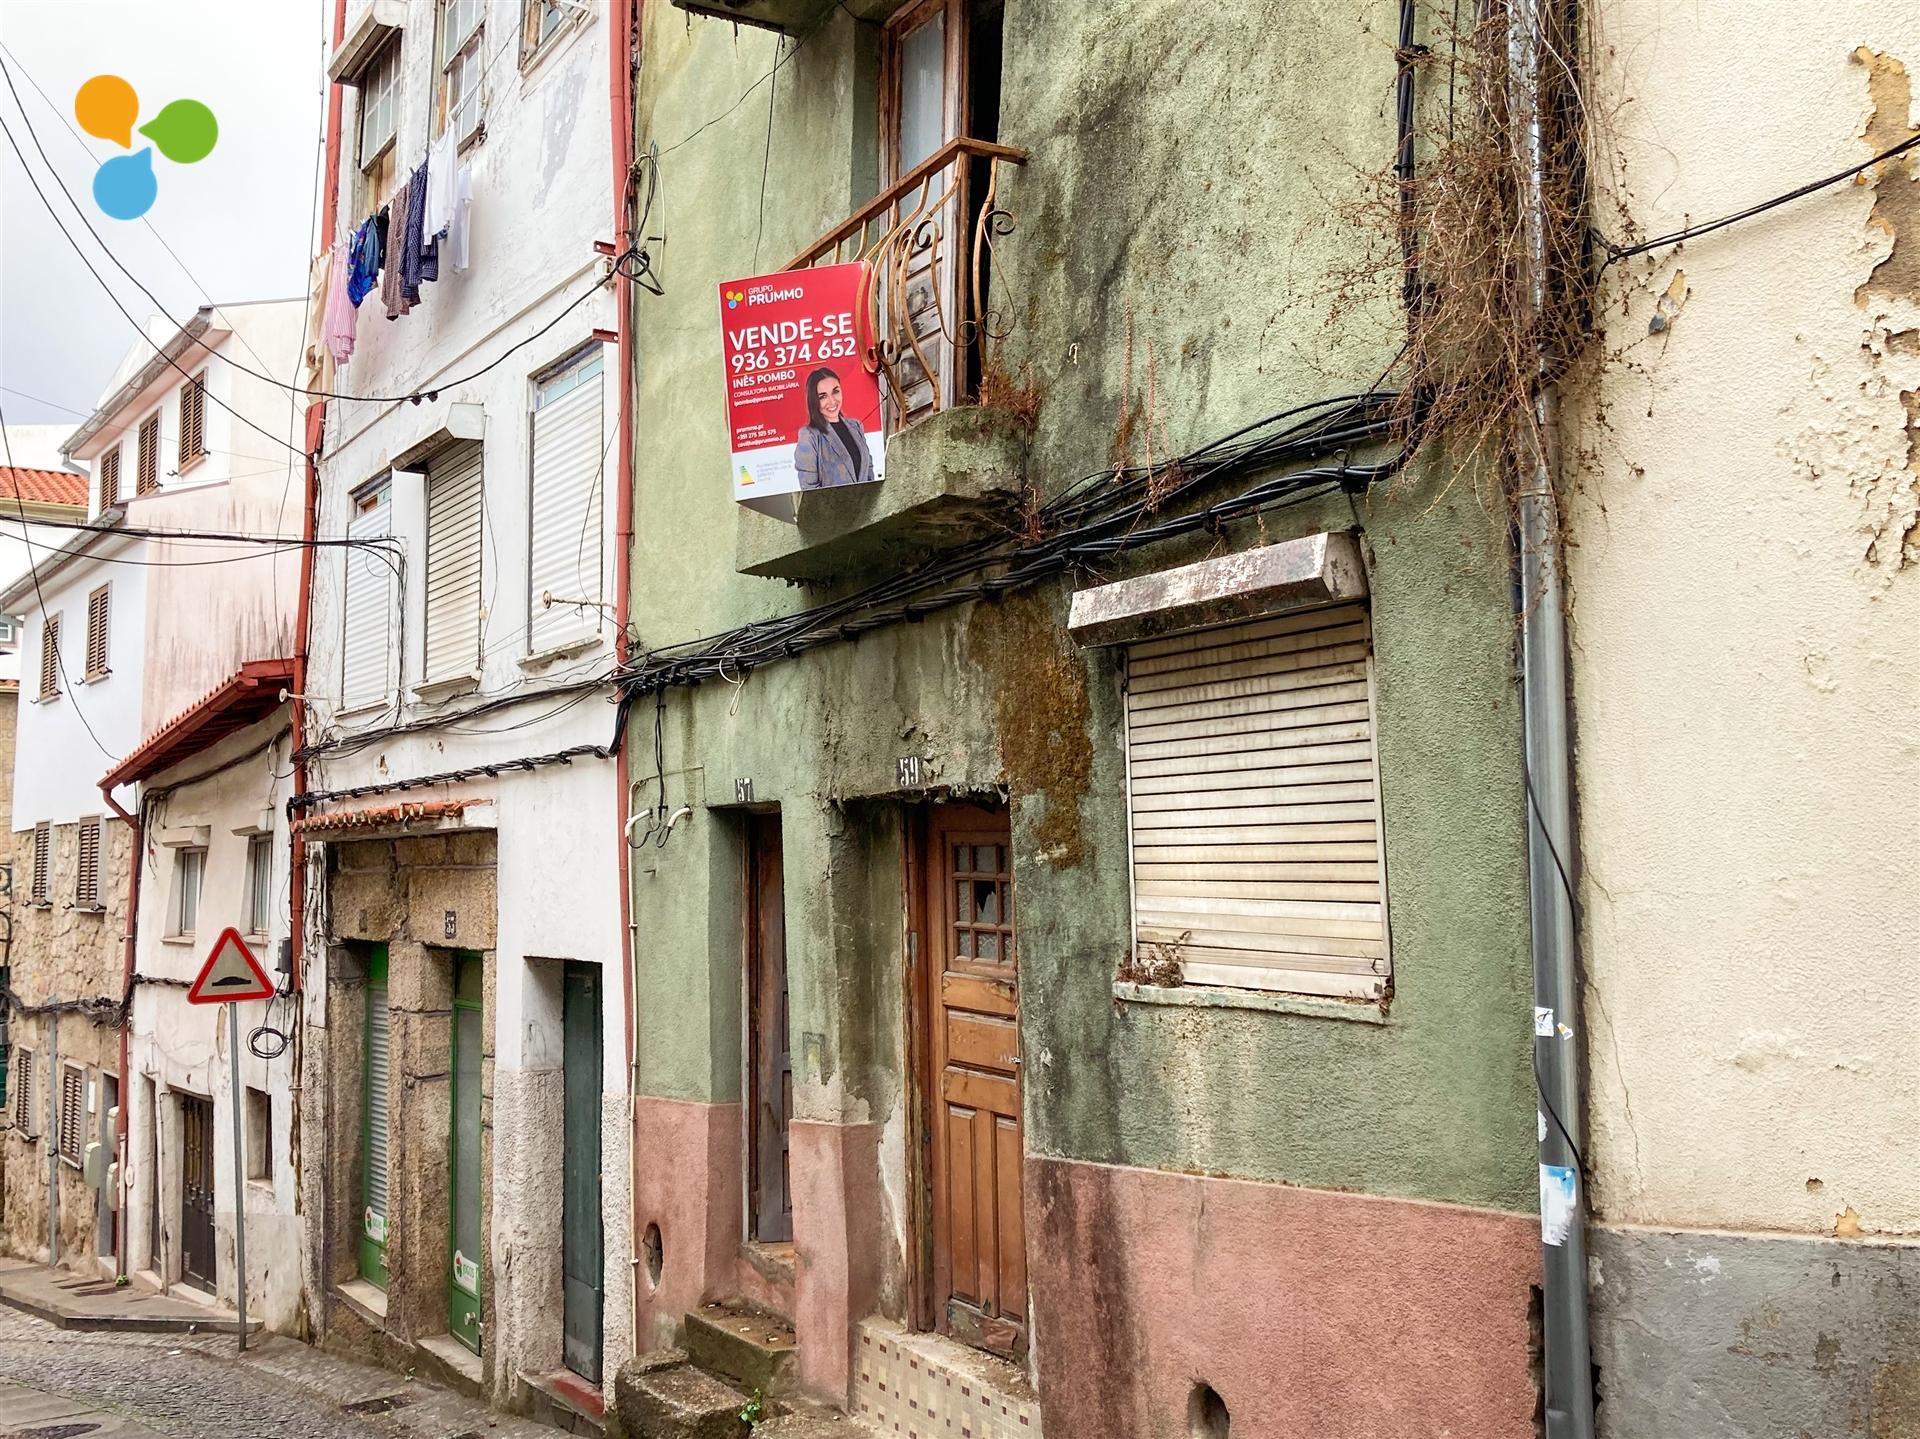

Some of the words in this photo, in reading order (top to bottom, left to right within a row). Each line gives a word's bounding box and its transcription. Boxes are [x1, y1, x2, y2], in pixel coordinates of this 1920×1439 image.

[748, 284, 773, 295] GRUPO
[748, 287, 804, 306] PRUMMO
[729, 312, 853, 351] VENDE-SE
[731, 350, 769, 374] 936
[774, 343, 811, 366] 374
[817, 337, 856, 360] 652
[733, 375, 755, 389] INÊS
[757, 370, 796, 384] POMBO
[733, 387, 768, 398] CONSULTORA
[900, 756, 918, 787] 59
[737, 777, 751, 801] 57
